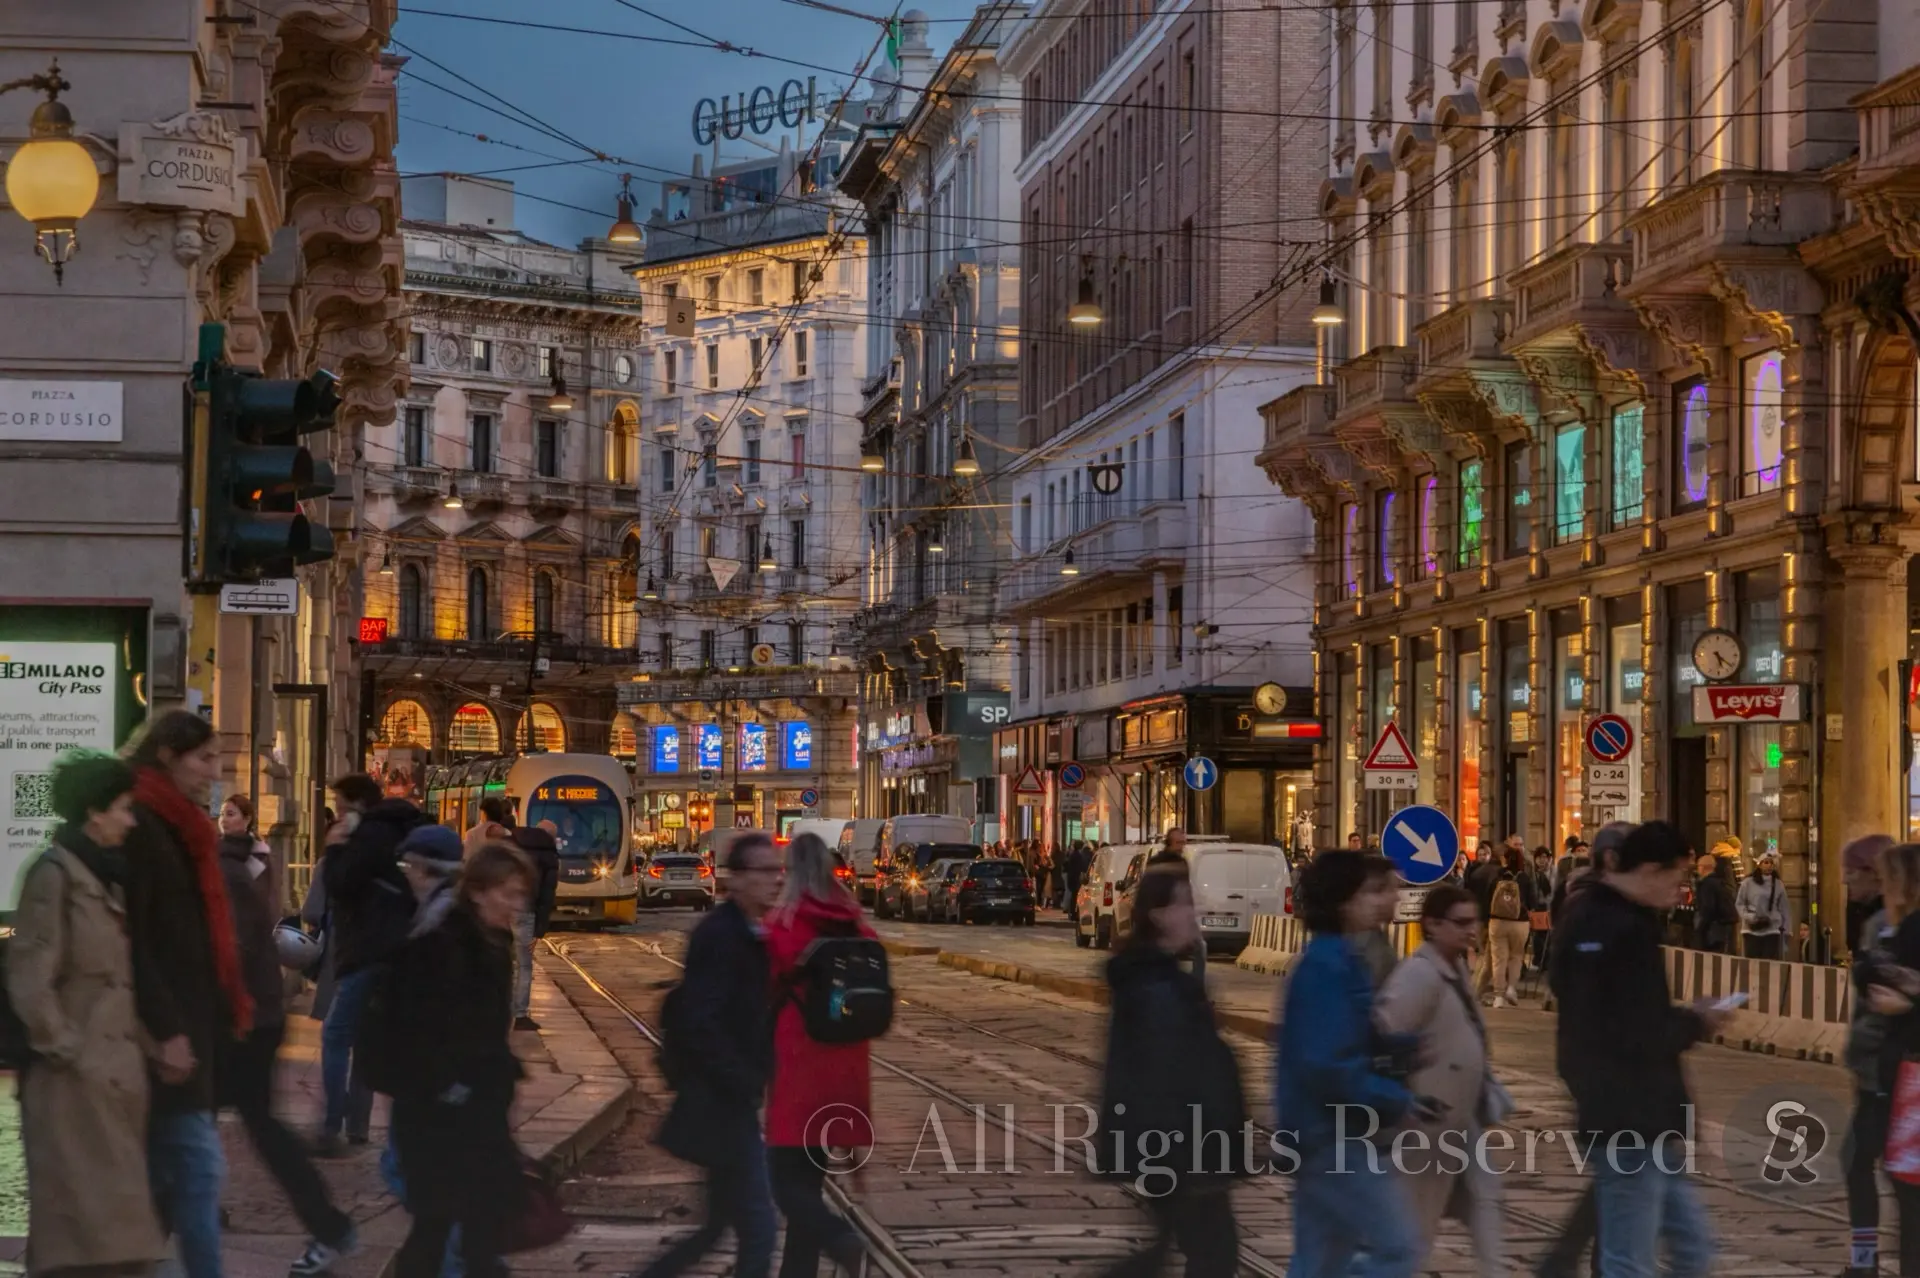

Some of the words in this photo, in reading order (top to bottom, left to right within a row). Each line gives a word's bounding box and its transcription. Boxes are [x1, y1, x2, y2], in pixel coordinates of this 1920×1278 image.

[692, 76, 816, 145] GUCCI
[178, 147, 214, 160] PIAZZA
[148, 160, 231, 187] CORDUSIO
[677, 311, 686, 324] 5
[32, 390, 75, 400] PIAZZA
[0, 412, 111, 426] CORDUSIO
[27, 664, 105, 678] MILANO
[38, 681, 67, 698] City
[70, 682, 102, 694] Pass
[1716, 694, 1777, 710] Levi's
[40, 712, 99, 724] attractions,
[981, 706, 1012, 723] SP
[8, 724, 42, 738] public
[46, 727, 95, 738] transport
[16, 738, 27, 749] in
[31, 742, 52, 750] one
[1378, 776, 1392, 784] 30
[1610, 770, 1624, 779] 24
[538, 788, 549, 800] 14
[7, 827, 24, 836] Get
[27, 827, 42, 836] the
